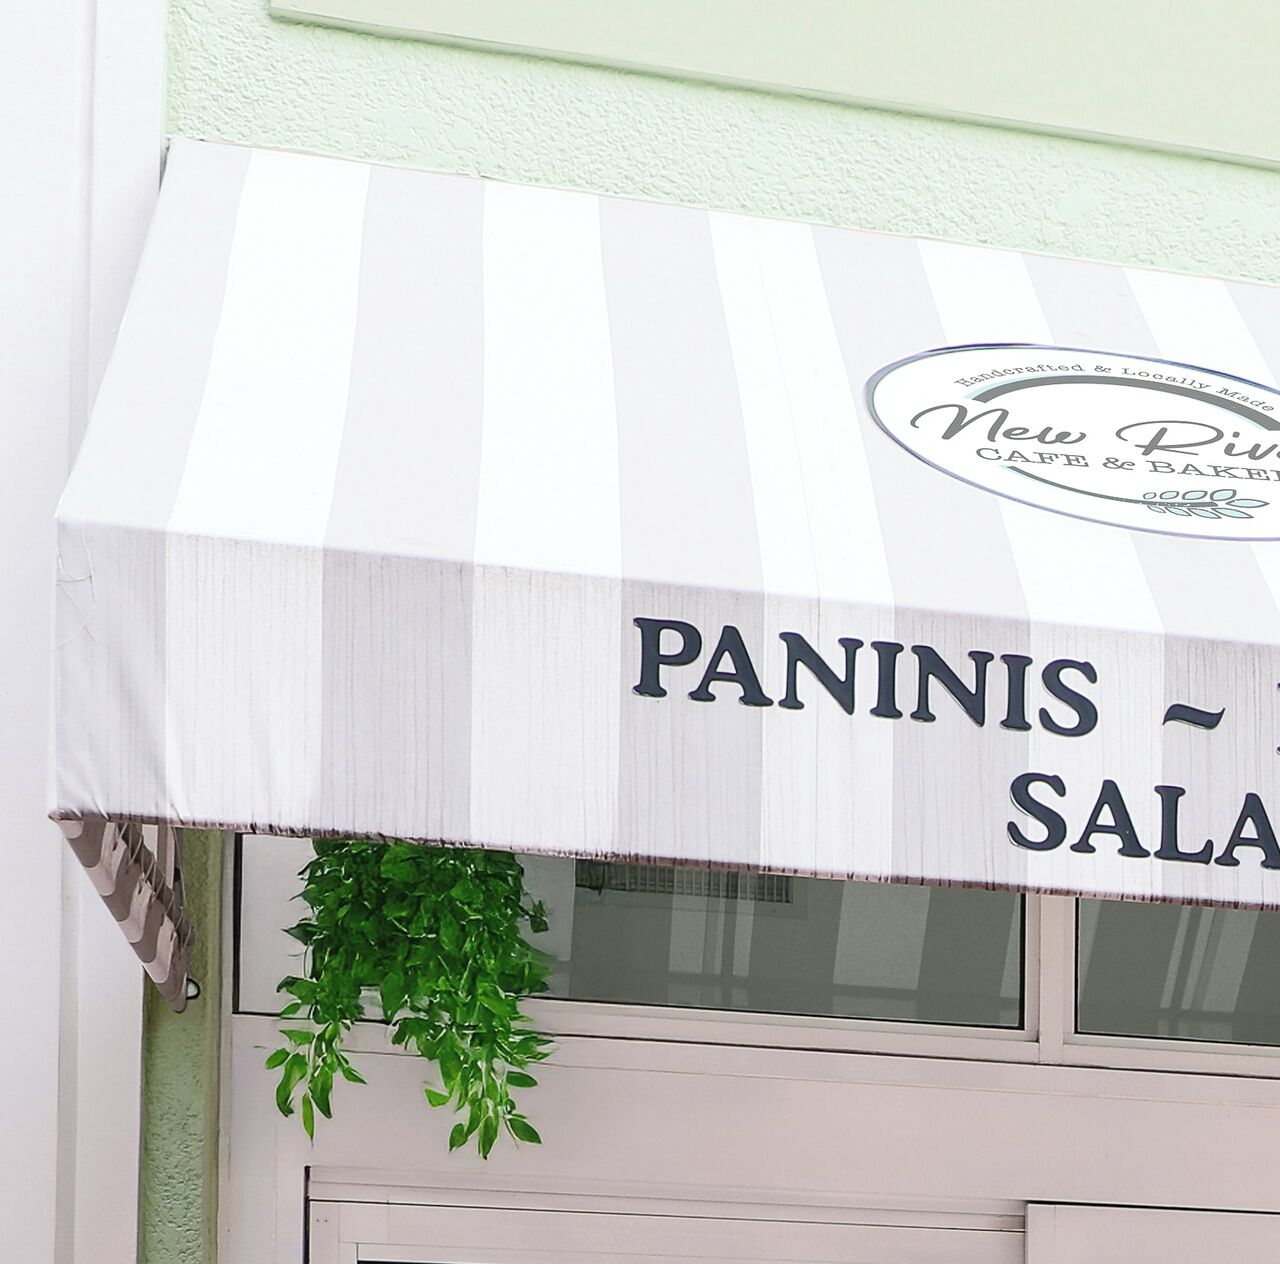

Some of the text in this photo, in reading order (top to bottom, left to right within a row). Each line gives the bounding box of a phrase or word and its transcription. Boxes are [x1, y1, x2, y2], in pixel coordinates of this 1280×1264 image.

[954, 364, 1275, 412] Handcrafted & Locally Made
[910, 403, 1087, 445] New
[976, 447, 1089, 467] CAFE
[1102, 457, 1135, 470] &
[632, 617, 1098, 738] PANINIS
